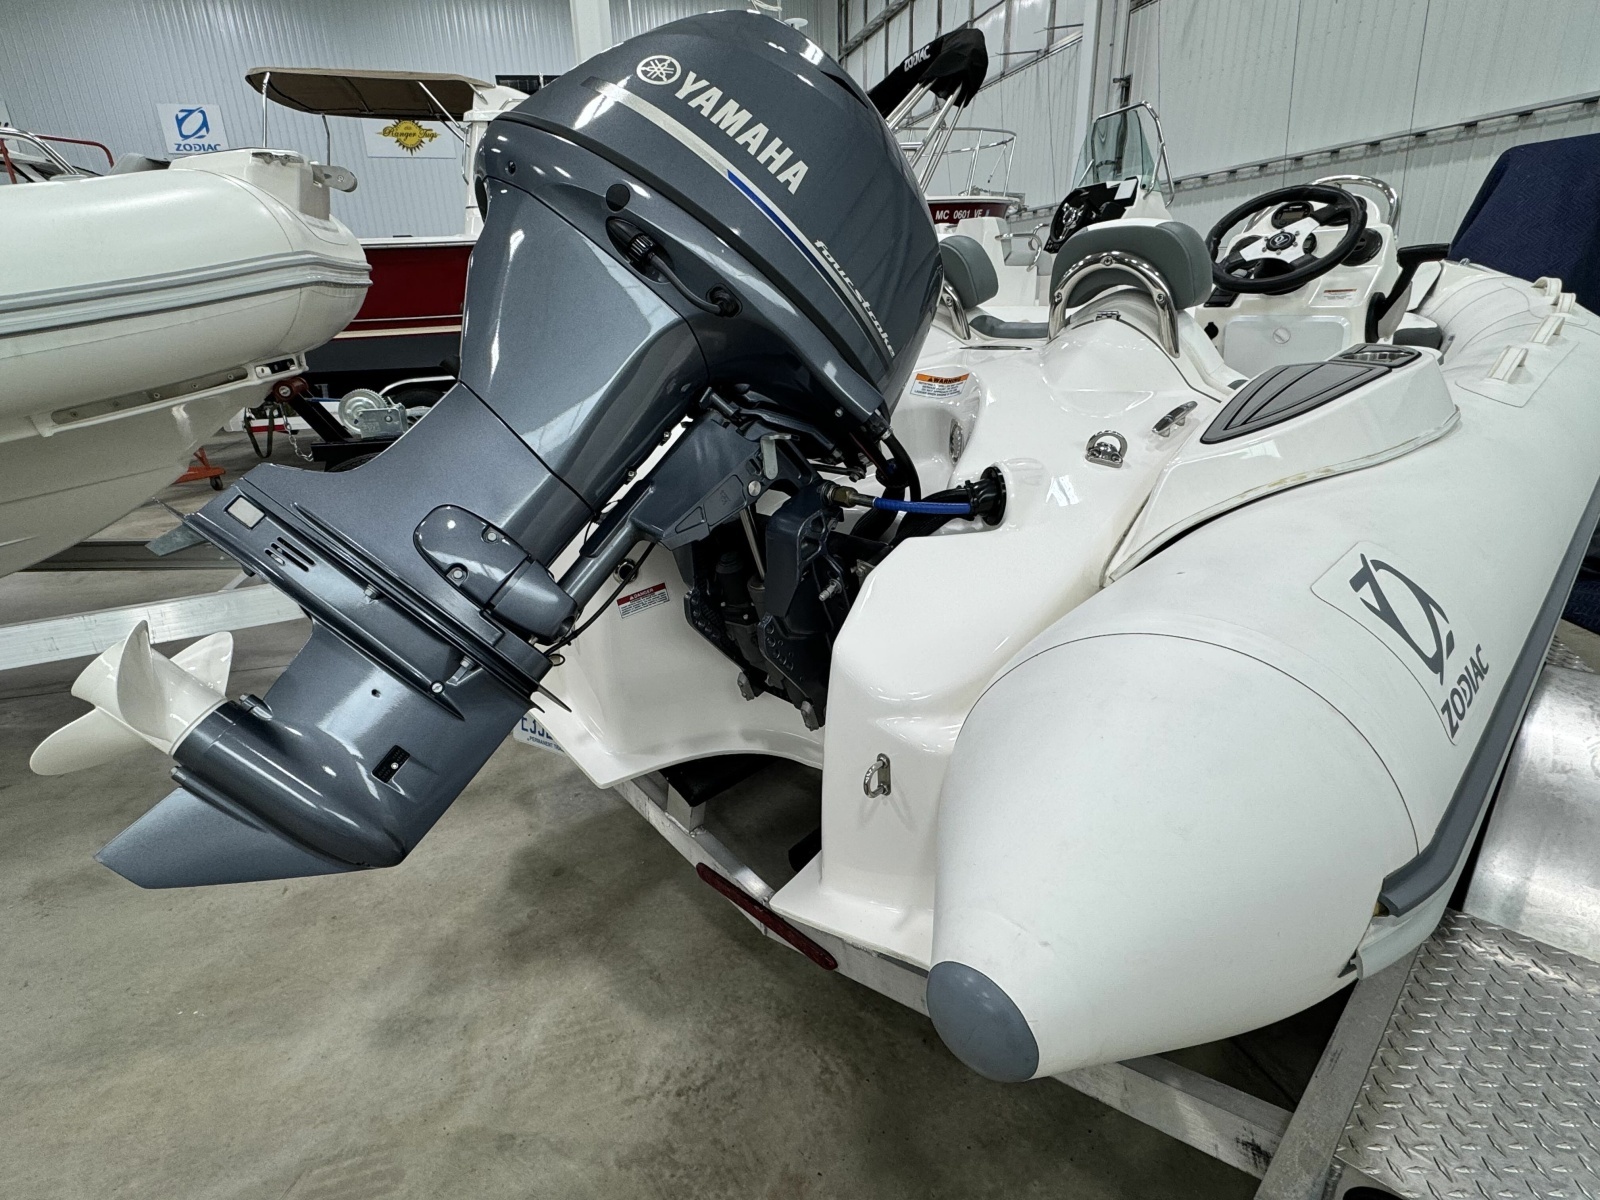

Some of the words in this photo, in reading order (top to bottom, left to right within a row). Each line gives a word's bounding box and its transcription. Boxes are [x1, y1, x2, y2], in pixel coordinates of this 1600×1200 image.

[903, 45, 931, 72] ZODIAC
[382, 126, 417, 141] Ranger
[418, 128, 438, 142] Tugs
[675, 71, 809, 195] YAMAHA
[174, 143, 221, 152] ZODIAC
[935, 209, 950, 220] MC
[953, 209, 971, 220] 0601
[1440, 643, 1490, 739] ZODIAC
